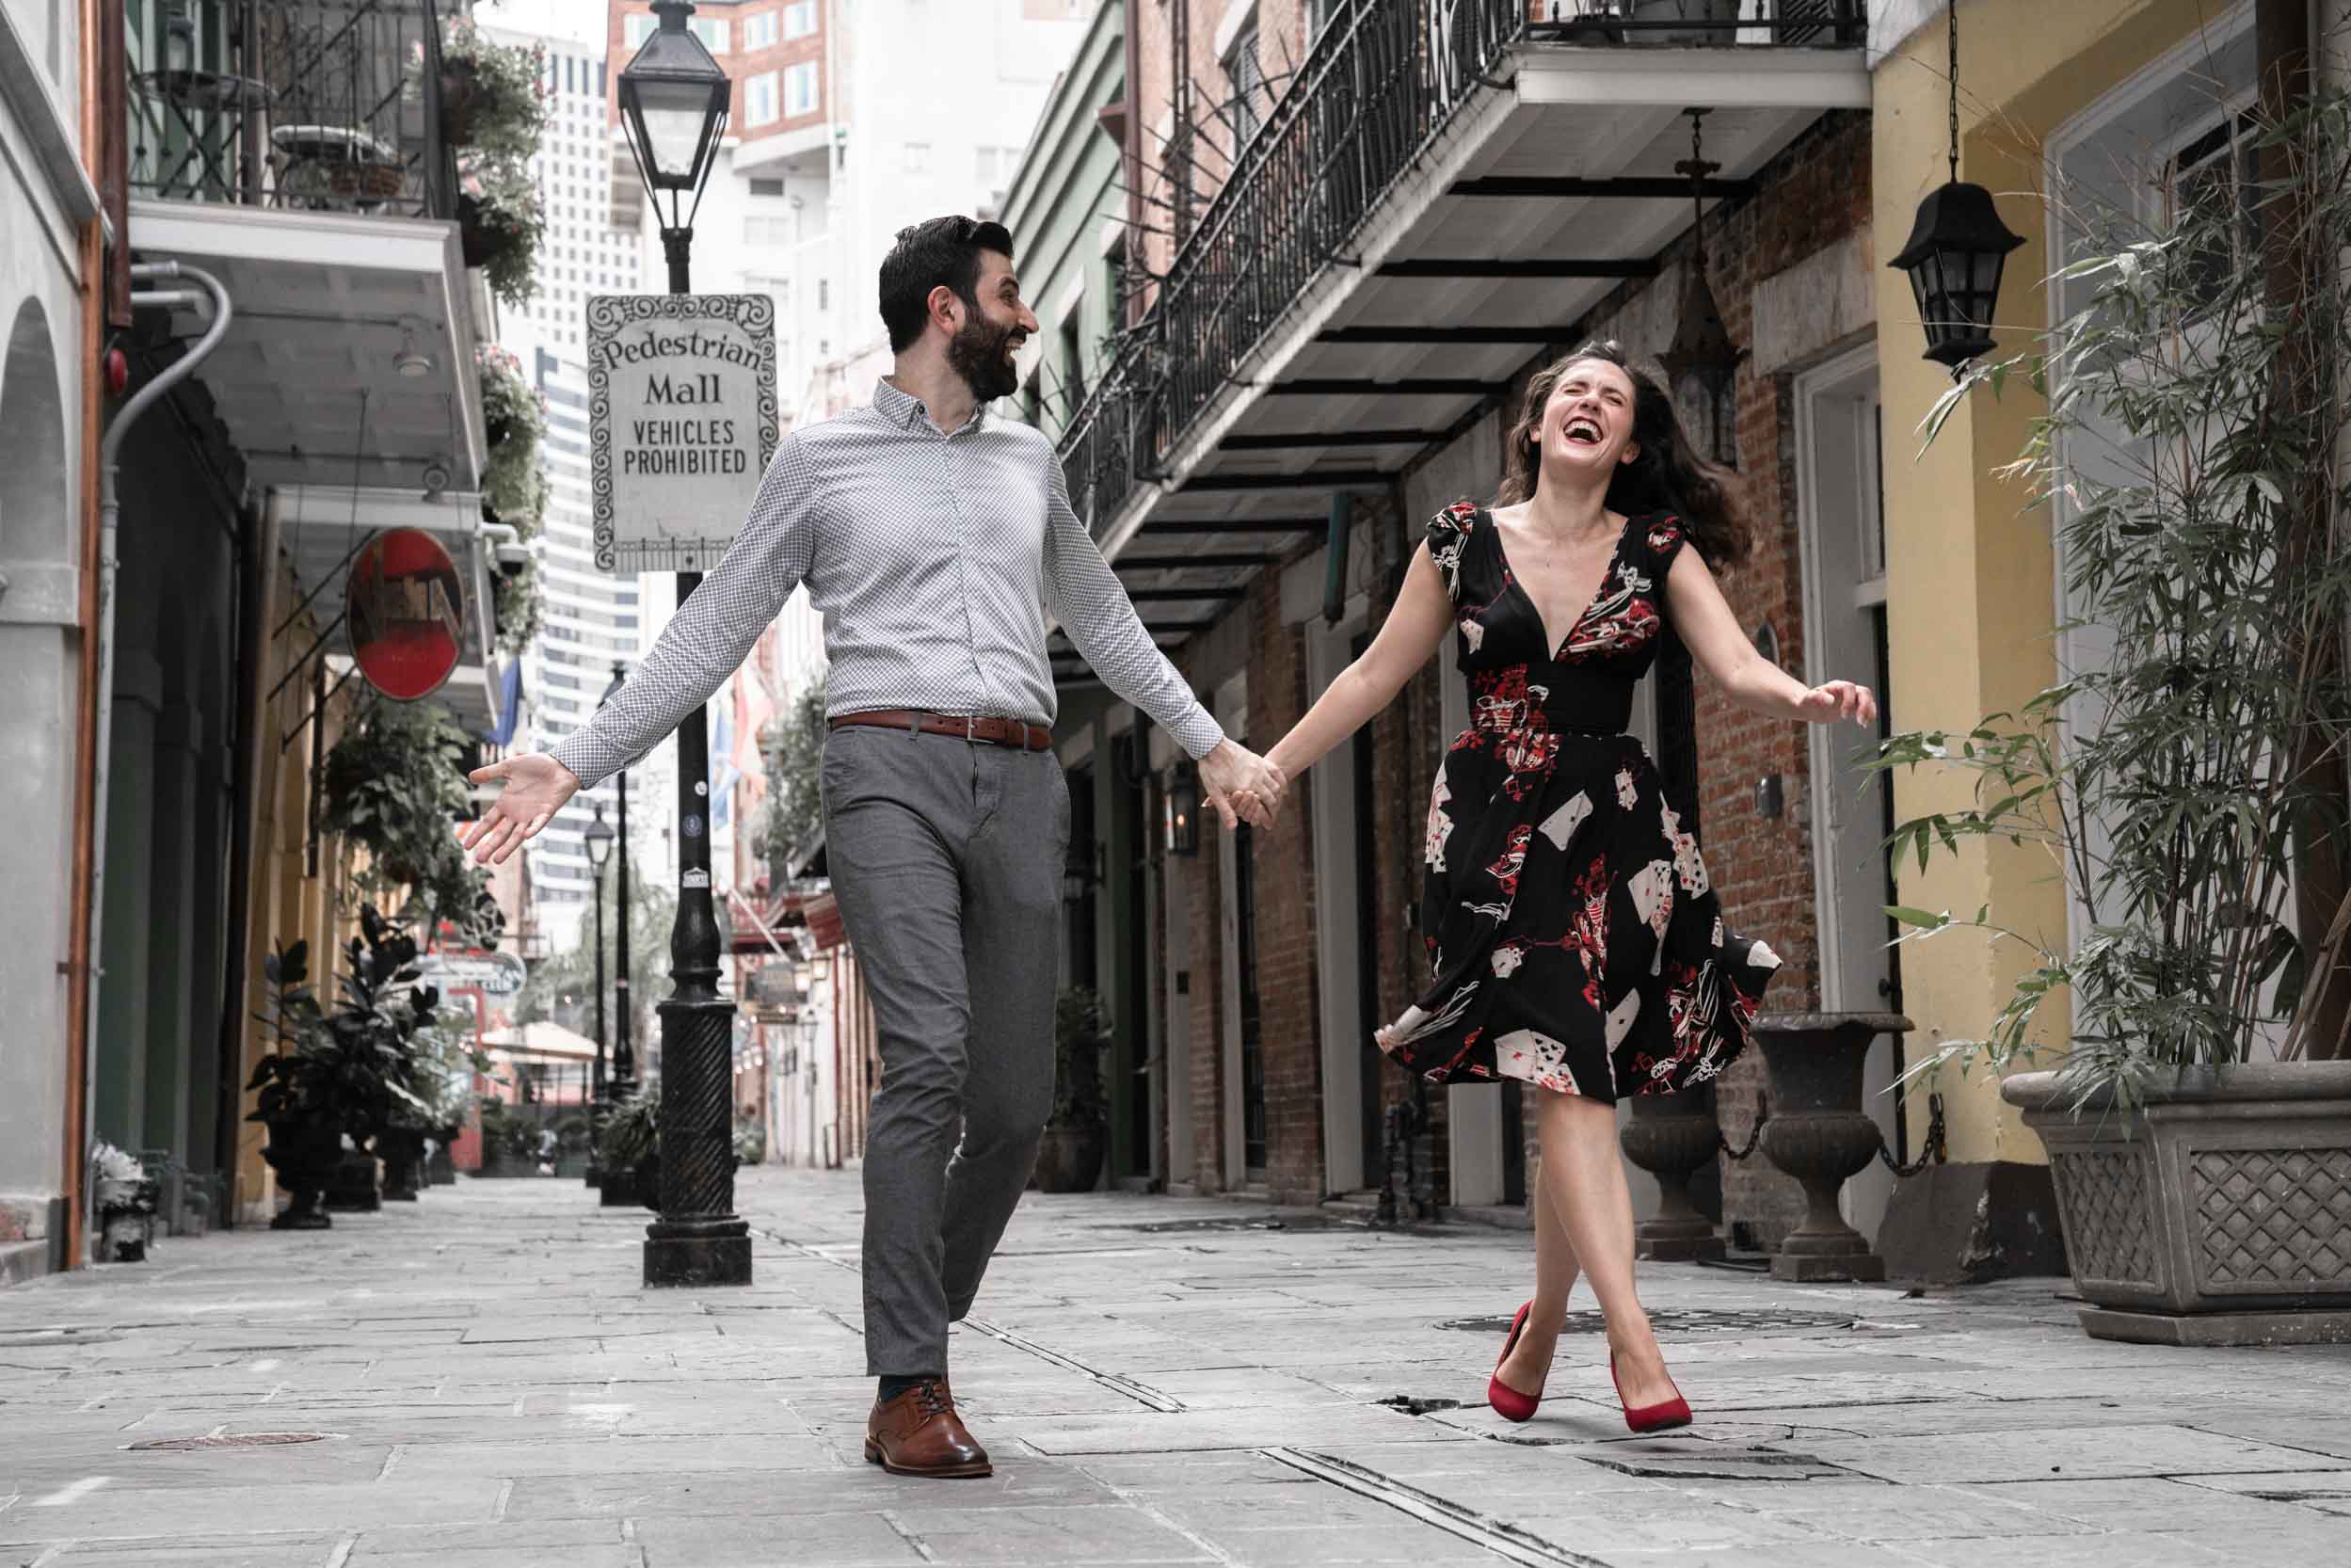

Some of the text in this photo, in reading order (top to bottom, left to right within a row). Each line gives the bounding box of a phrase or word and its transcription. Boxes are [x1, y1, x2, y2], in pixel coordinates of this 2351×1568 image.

[603, 330, 762, 371] Pedestrian
[644, 374, 723, 405] Mall
[633, 421, 734, 445] VEHICLES
[625, 449, 745, 474] PROHIBITED
